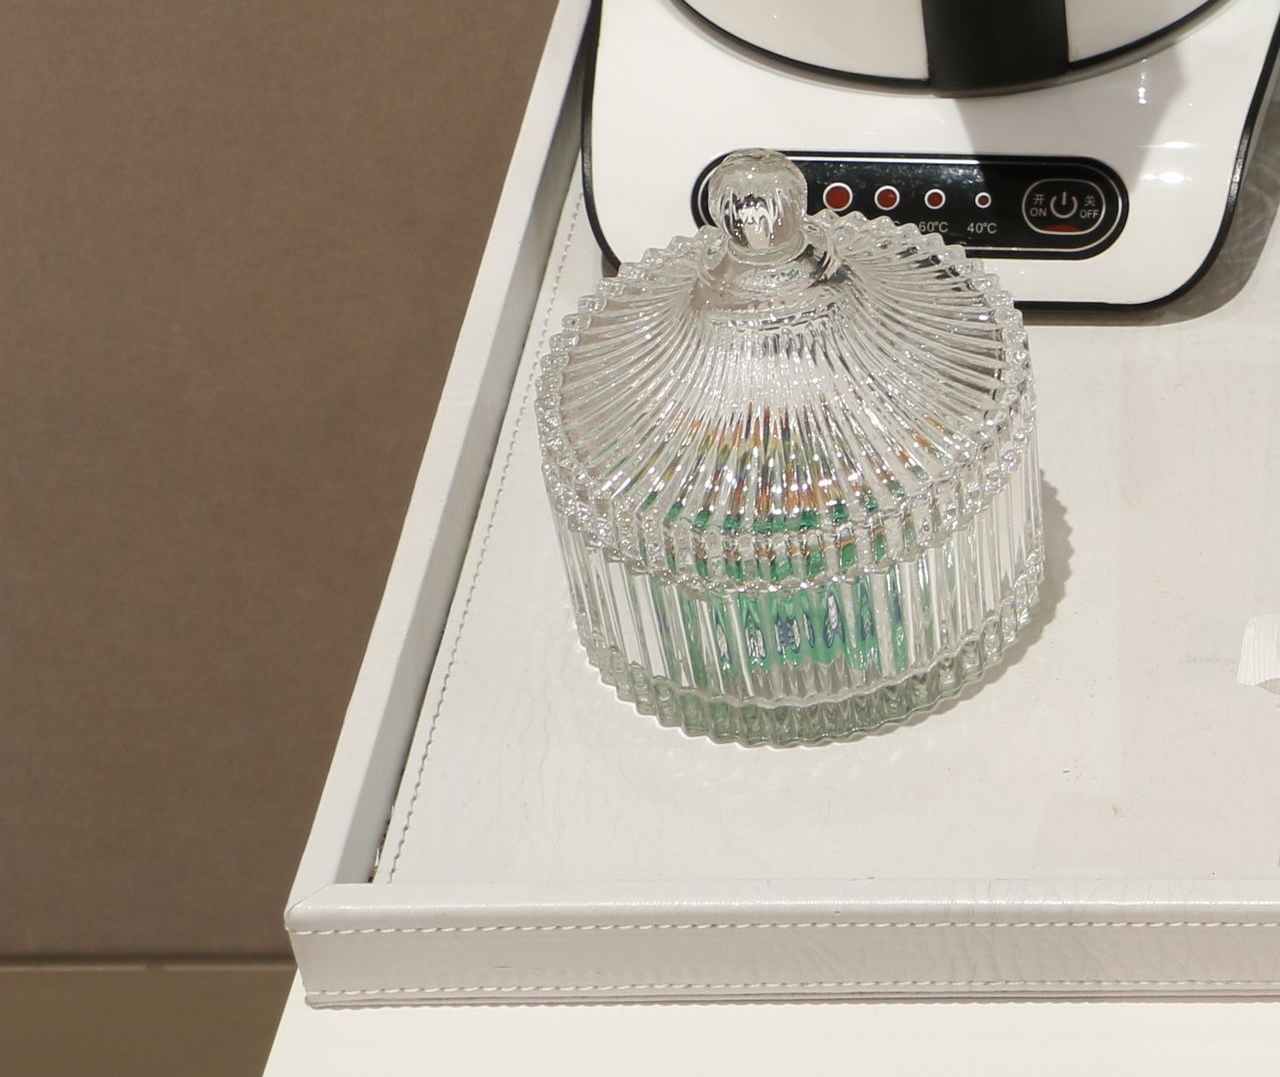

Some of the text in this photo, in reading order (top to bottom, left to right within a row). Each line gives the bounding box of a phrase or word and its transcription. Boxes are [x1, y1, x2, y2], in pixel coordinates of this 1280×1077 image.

[1033, 194, 1045, 206] 开
[1085, 194, 1097, 206] 关
[1030, 208, 1048, 218] ON
[1080, 210, 1099, 219] OFF
[918, 221, 997, 234] 60°C 40°C
